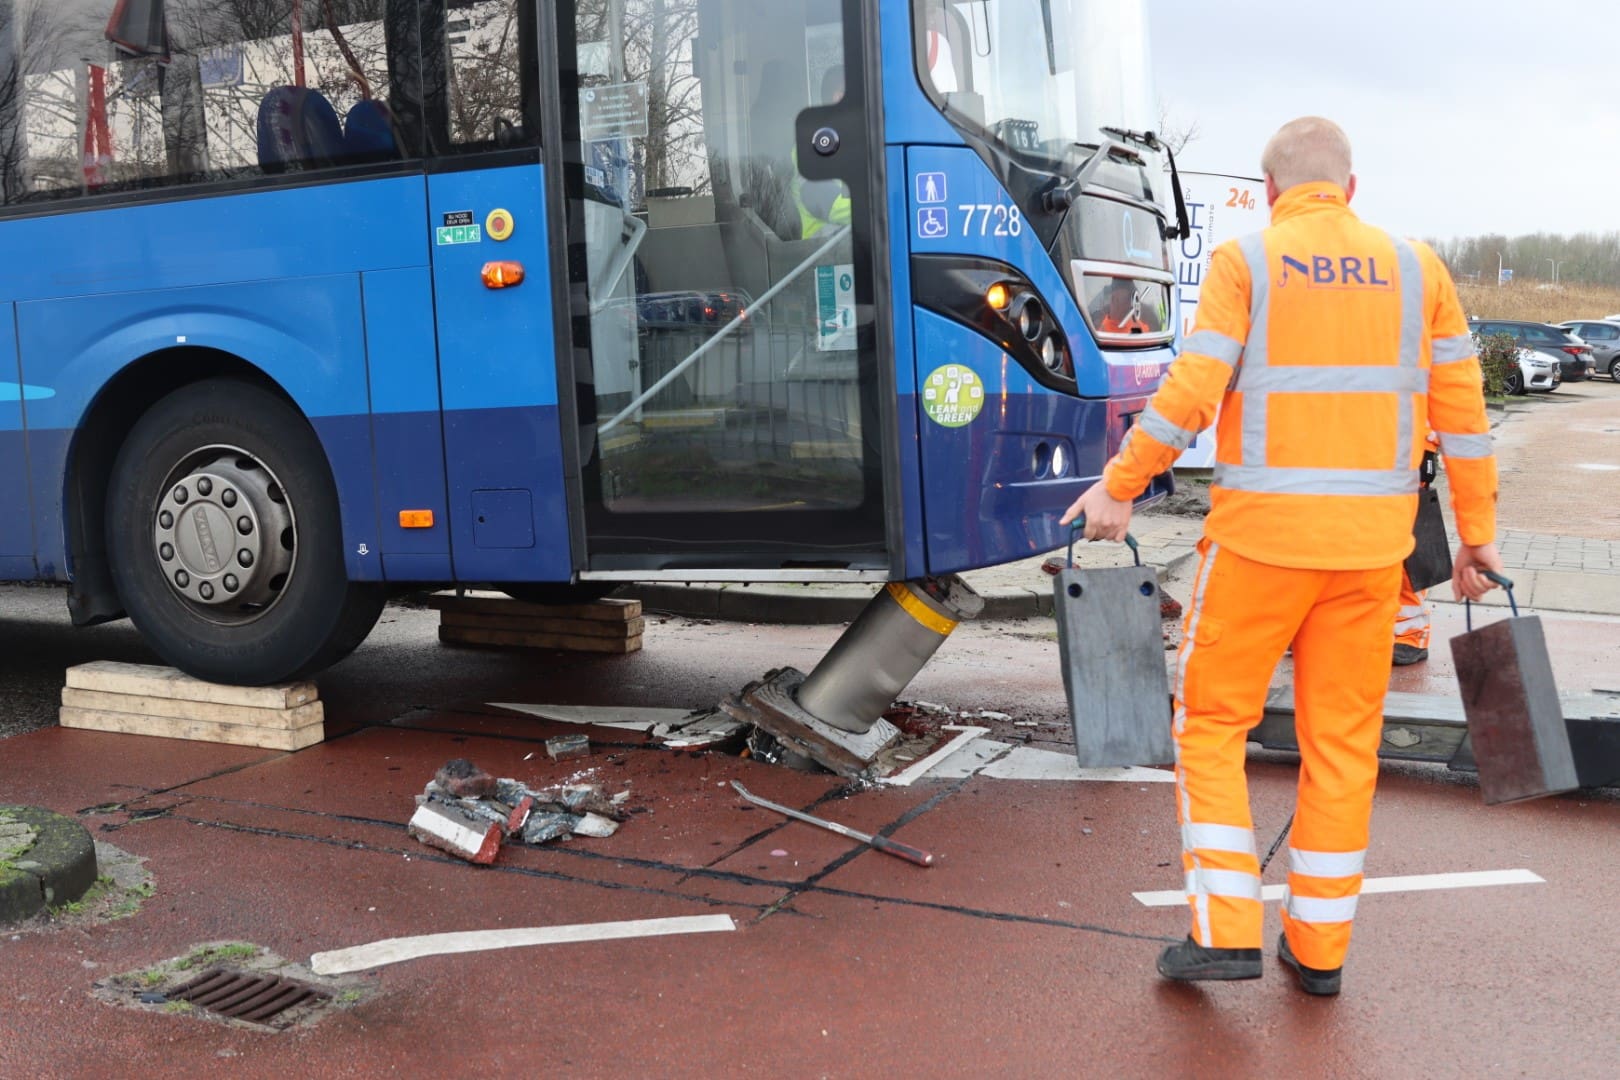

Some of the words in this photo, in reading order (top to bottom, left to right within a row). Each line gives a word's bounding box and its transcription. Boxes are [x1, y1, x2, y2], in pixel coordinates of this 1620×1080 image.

[958, 204, 1021, 237] 7728
[1312, 254, 1388, 286] BRL
[930, 404, 958, 414] LEAN
[936, 412, 972, 423] GREEN
